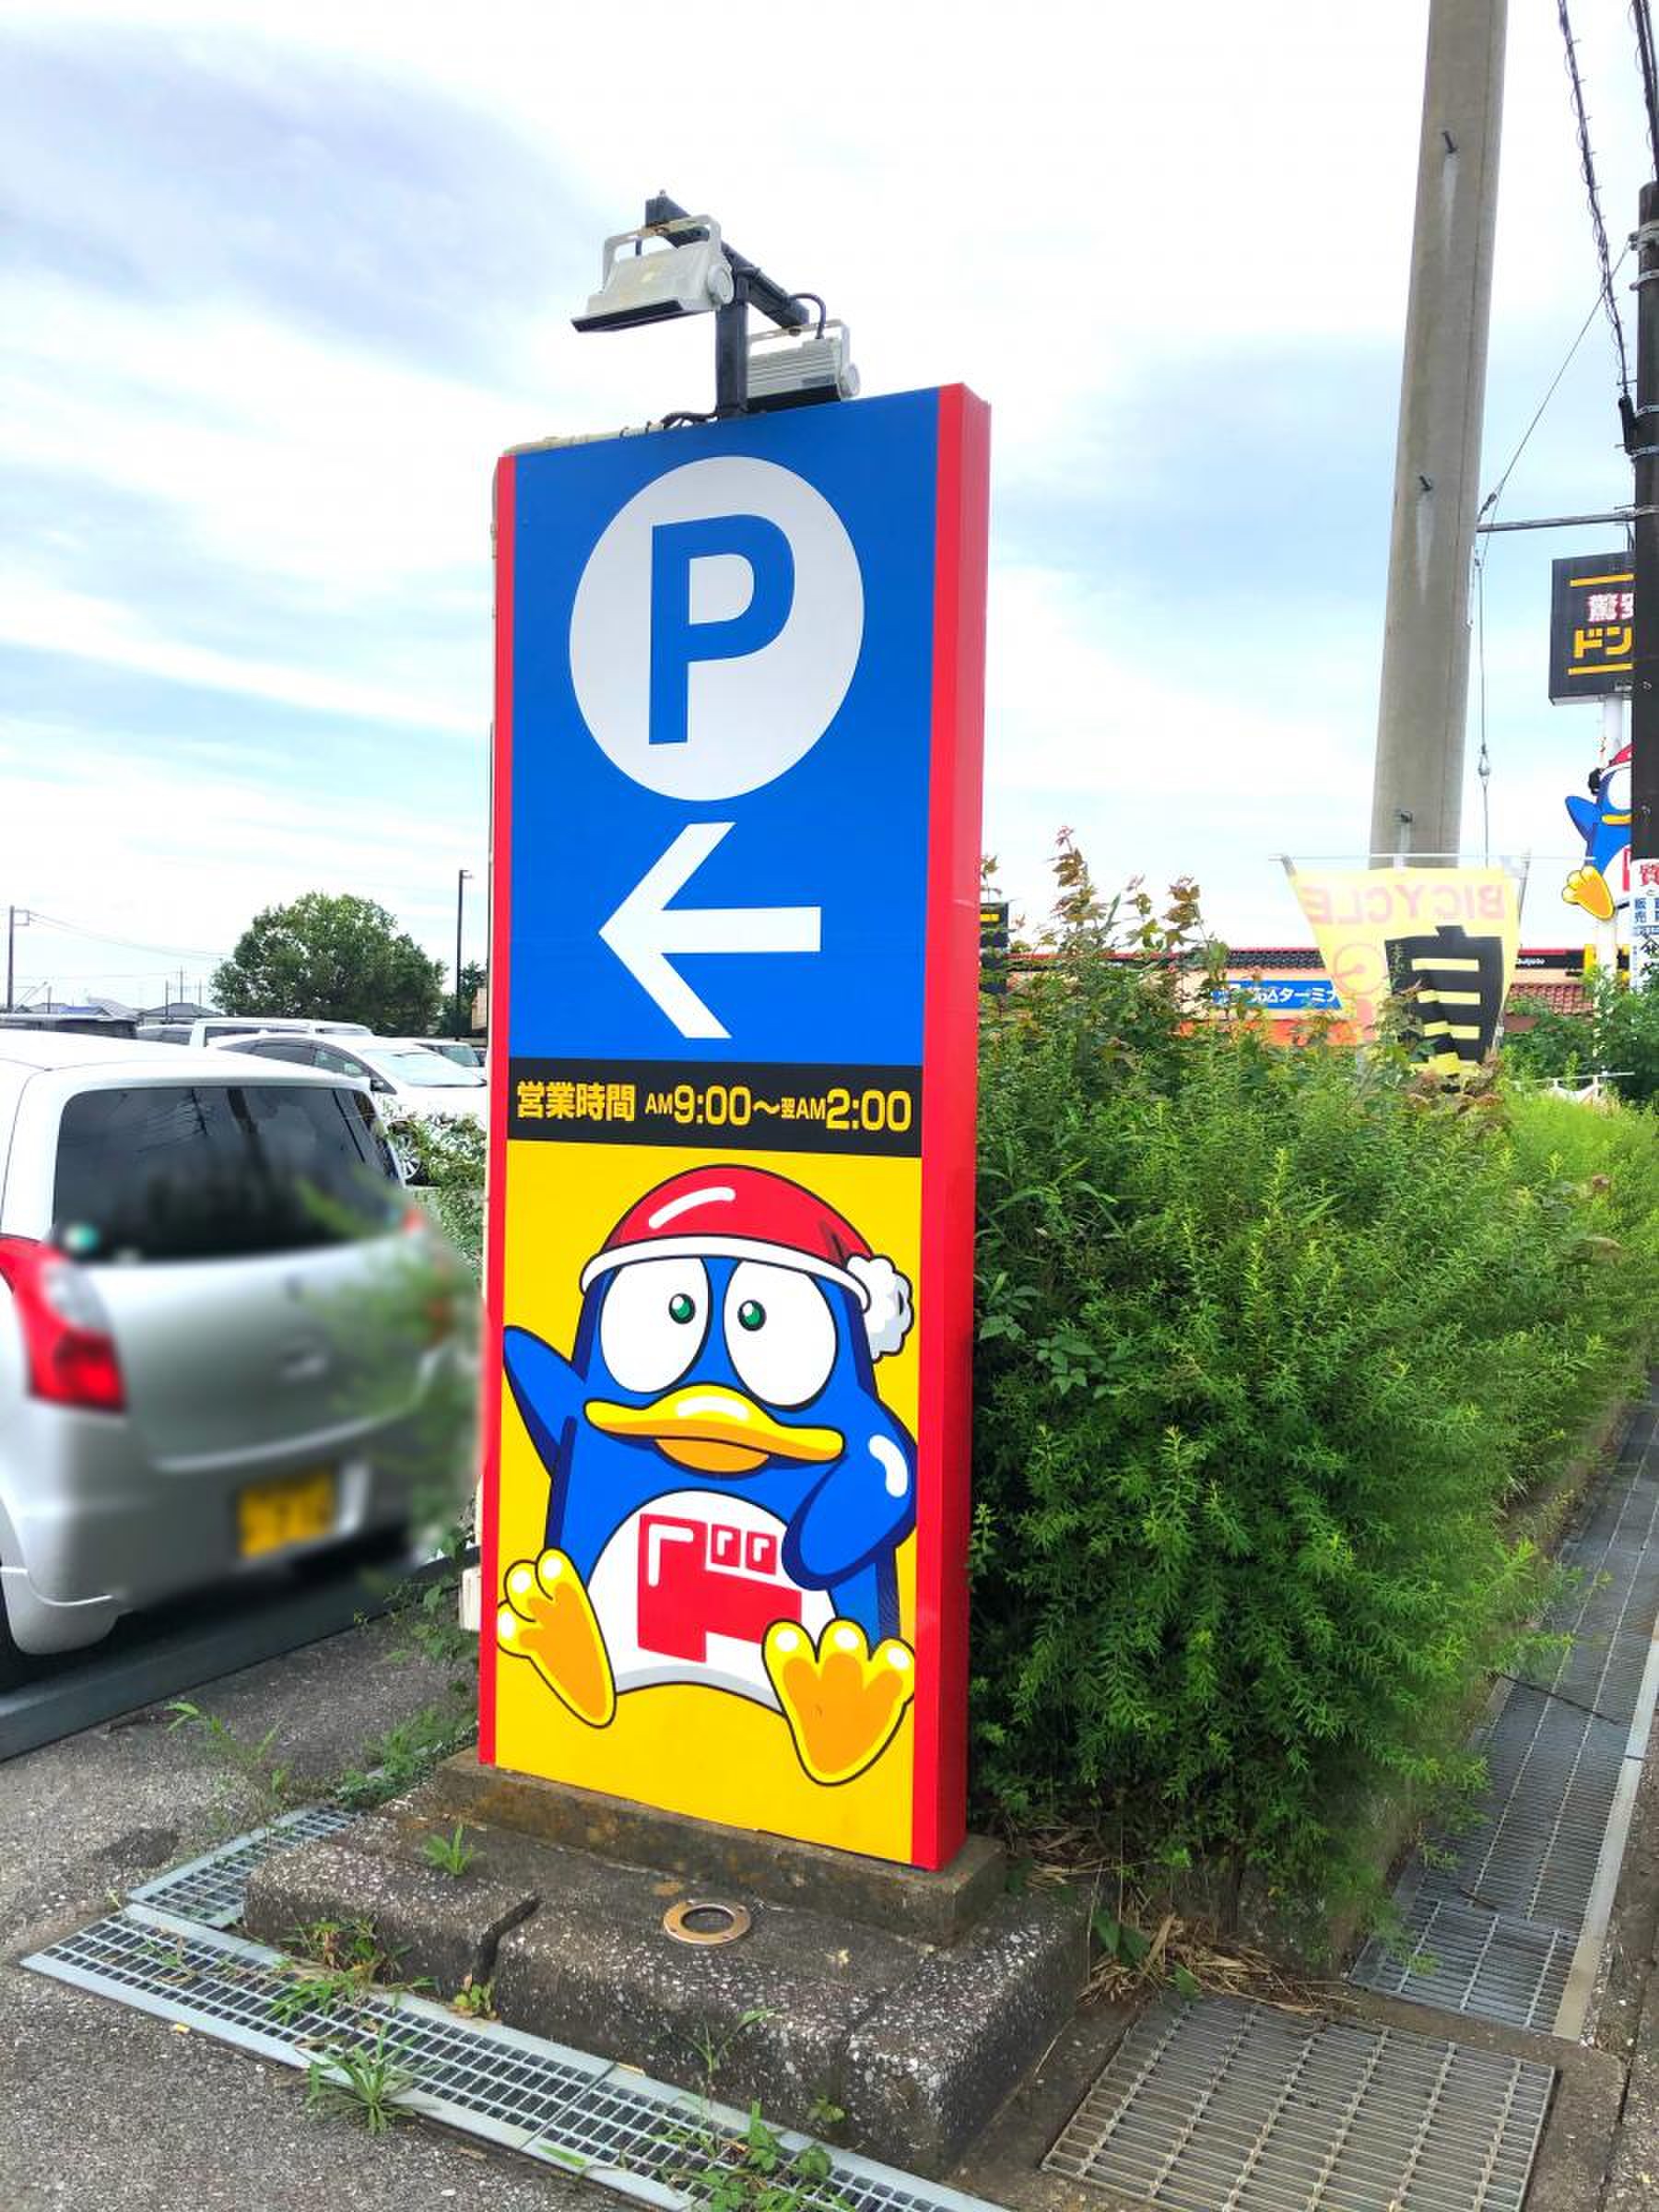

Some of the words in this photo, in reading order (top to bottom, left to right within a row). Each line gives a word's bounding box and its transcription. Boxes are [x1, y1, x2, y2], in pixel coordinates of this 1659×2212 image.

[649, 514, 795, 745] P
[517, 1080, 636, 1121] 営業時間
